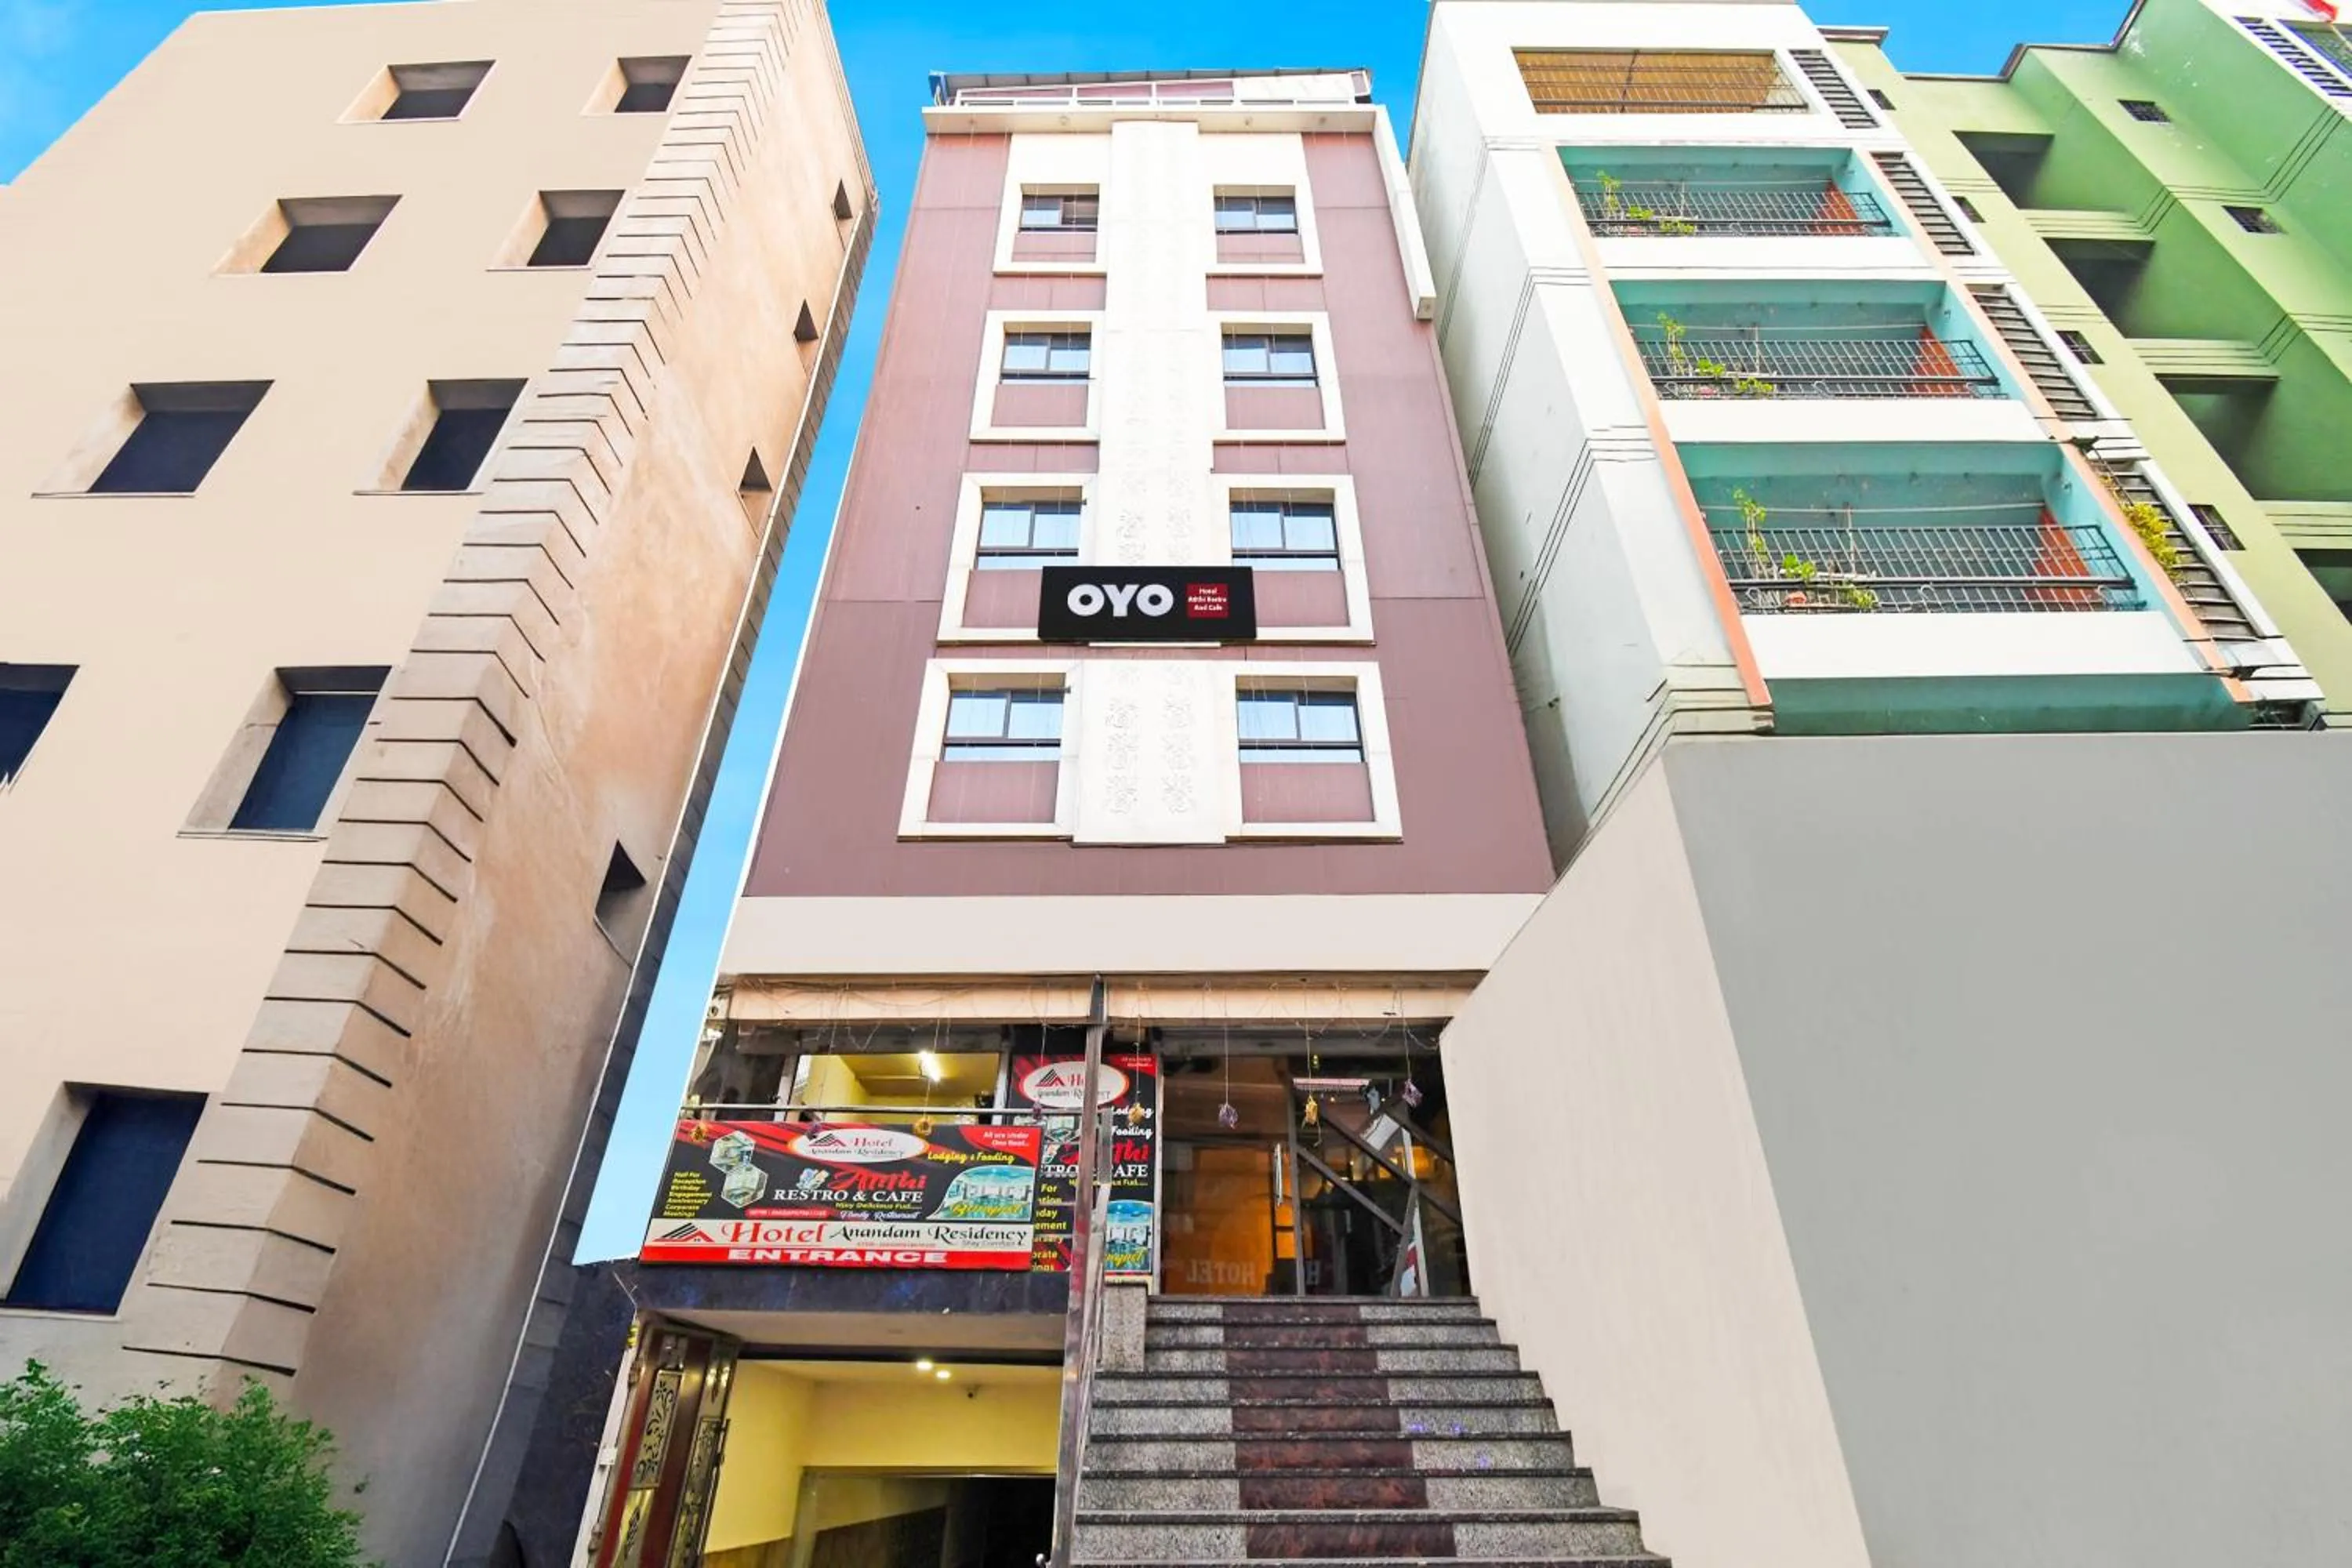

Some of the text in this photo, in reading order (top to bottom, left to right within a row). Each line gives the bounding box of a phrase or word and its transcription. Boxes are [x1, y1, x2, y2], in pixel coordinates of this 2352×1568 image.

[1067, 584, 1174, 616] OYO
[851, 1137, 894, 1147] Hotel
[928, 1152, 967, 1164] Lodging
[1114, 1164, 1149, 1177] AFE
[1040, 1183, 1058, 1193] For
[773, 1189, 924, 1203] RESTRO & CAFE
[721, 1222, 1027, 1246] Hotel Anandam Residency
[728, 1249, 948, 1263] ENTRANCE
